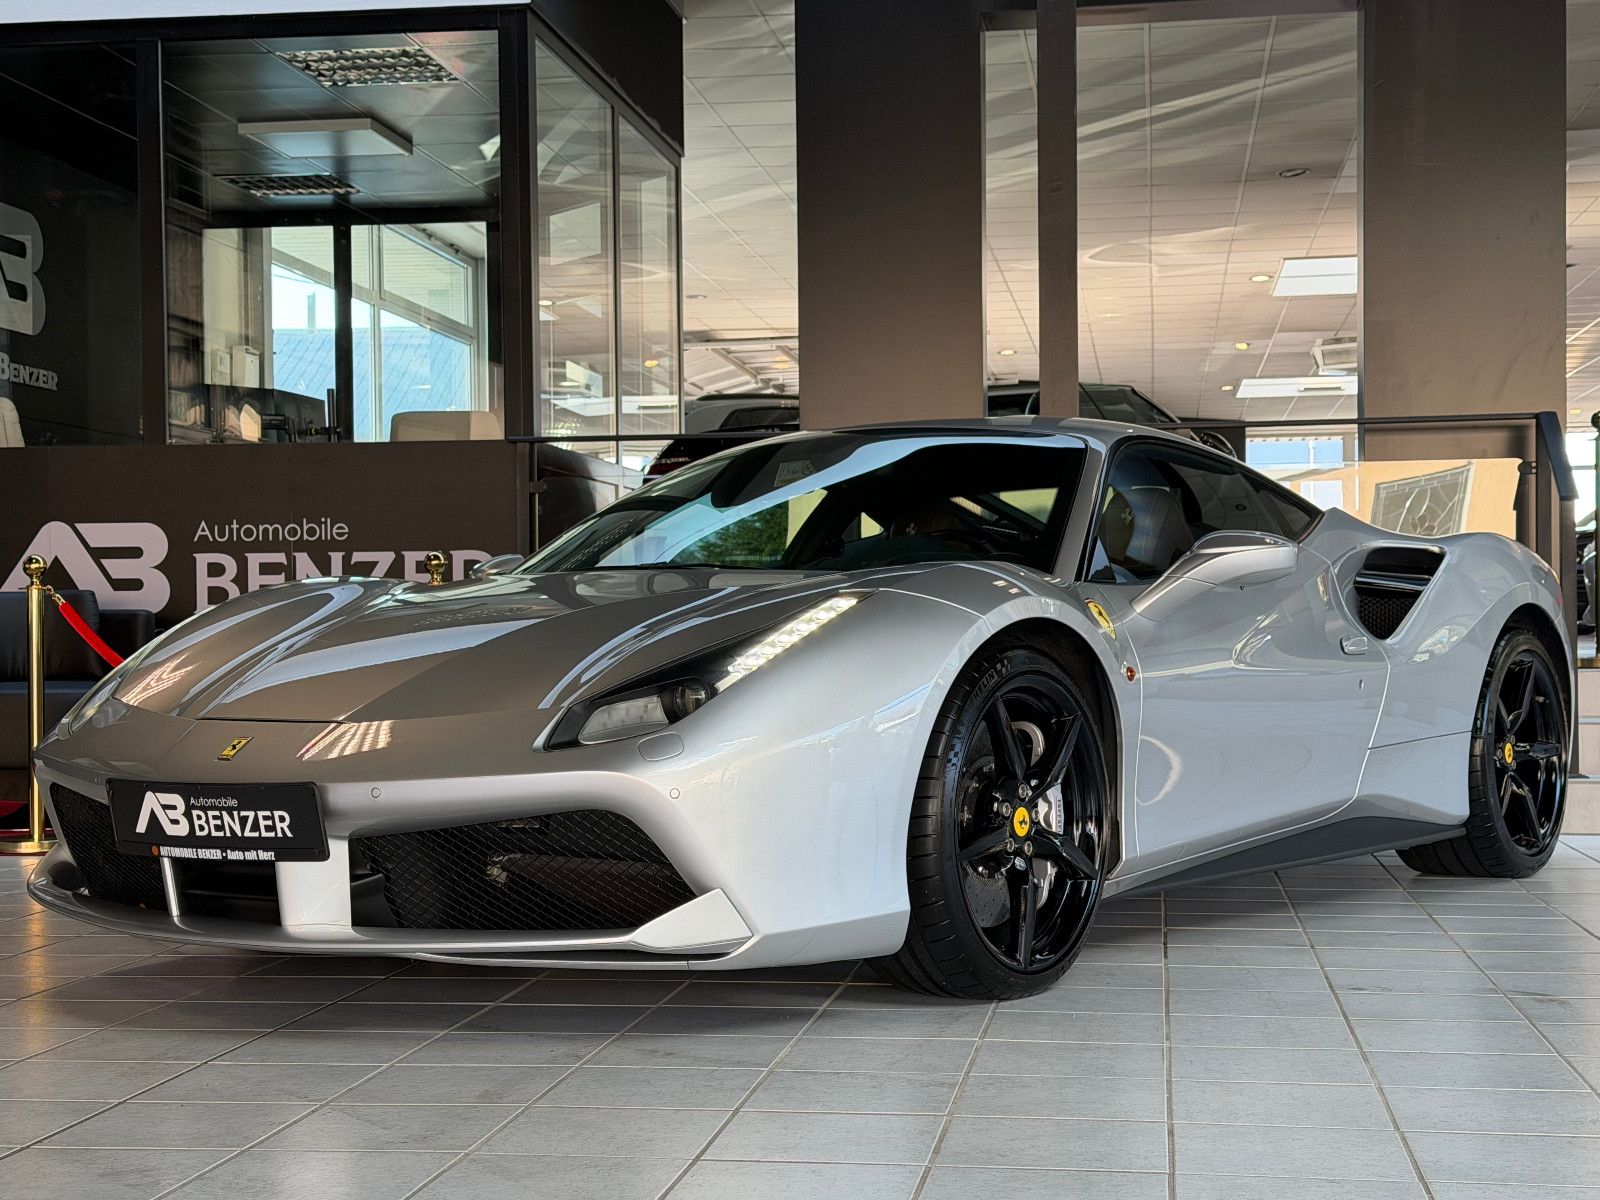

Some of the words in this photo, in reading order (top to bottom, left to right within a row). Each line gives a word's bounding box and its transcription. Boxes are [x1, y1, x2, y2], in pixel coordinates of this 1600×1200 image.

[193, 517, 350, 542] Automobile
[189, 796, 239, 807] Automobile
[191, 809, 294, 838] BENZER
[160, 846, 198, 859] AUTOMOBILE
[197, 848, 223, 860] BENZER
[226, 849, 245, 860] Auto
[244, 849, 258, 860] mit
[258, 849, 276, 861] Herz
